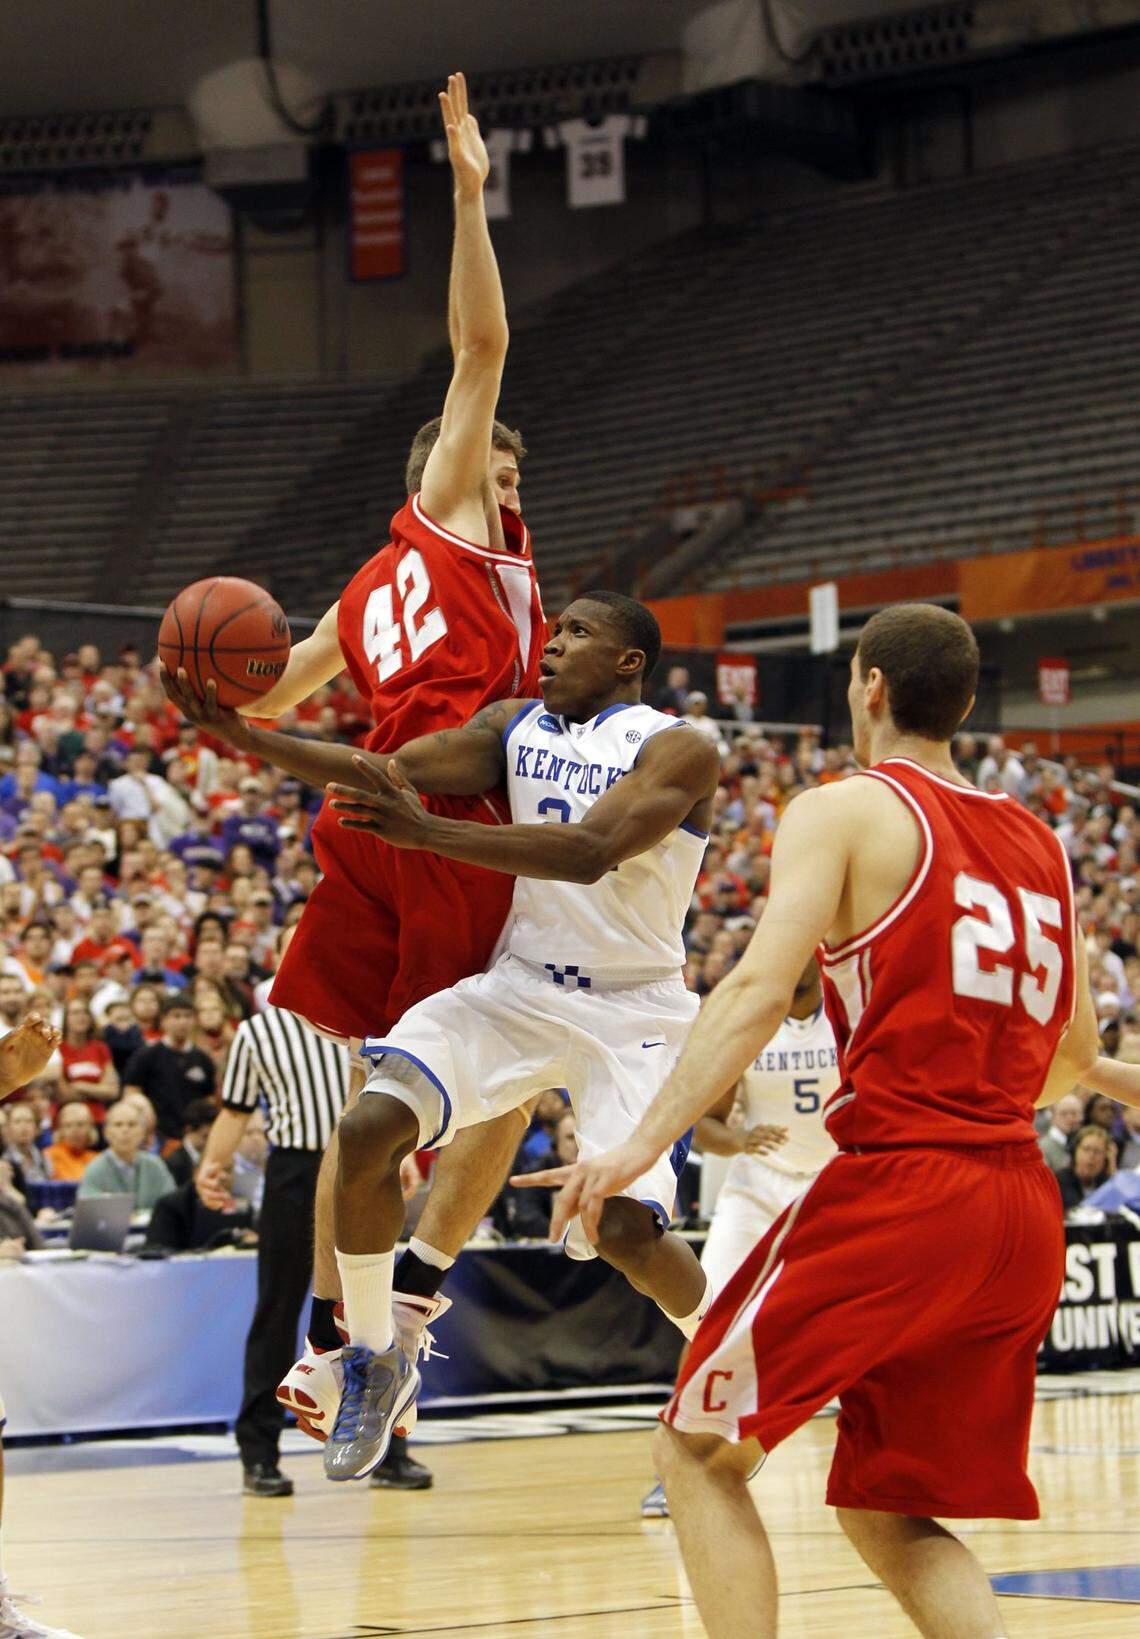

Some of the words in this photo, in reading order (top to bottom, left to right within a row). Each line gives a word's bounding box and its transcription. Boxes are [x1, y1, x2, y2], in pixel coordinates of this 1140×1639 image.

[363, 548, 448, 683] 42
[515, 744, 630, 795] KENTUCK
[952, 870, 1063, 1026] 25
[794, 1078, 820, 1114] 5
[1059, 1243, 1118, 1303] ST
[703, 1370, 733, 1413] C
